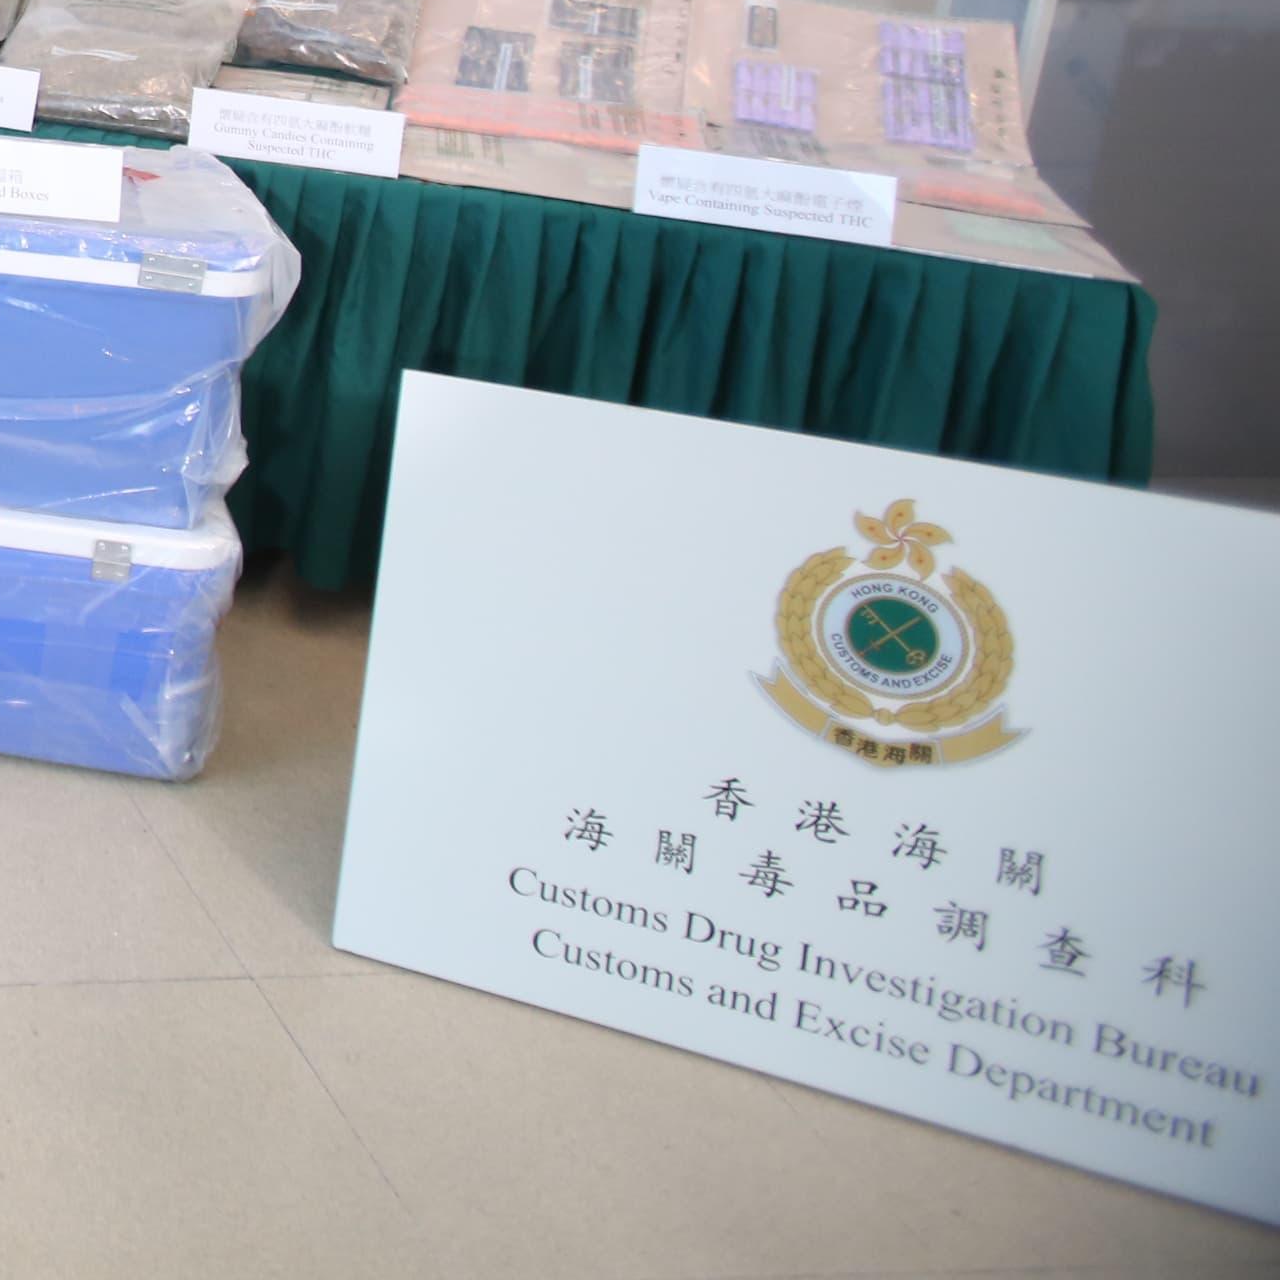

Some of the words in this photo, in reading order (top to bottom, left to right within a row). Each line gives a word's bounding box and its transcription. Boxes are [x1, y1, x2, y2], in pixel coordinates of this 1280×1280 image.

[213, 121, 259, 139] Gummy
[262, 127, 306, 142] Candies
[310, 134, 374, 153] Containing
[247, 139, 304, 157] Suspected
[308, 147, 338, 161] THC
[10, 187, 49, 202] Boxes
[648, 189, 680, 205] Vape
[684, 194, 759, 216] Containing
[763, 203, 834, 225] Suspected
[838, 213, 873, 229] THC
[851, 583, 893, 600] HONG
[898, 585, 939, 615] KONG
[831, 632, 880, 684] CUSTOMS
[881, 677, 912, 689] AND
[914, 654, 953, 687] EXCISE
[834, 726, 933, 766] 香港海關
[703, 776, 1046, 897] 香港海關
[563, 806, 1207, 1010] 海關毒品調查科
[508, 865, 669, 934] Customs
[683, 911, 784, 972] Drug
[798, 941, 1075, 1048] Investigation
[1091, 1022, 1262, 1102] Bureau
[531, 927, 694, 999] Customs
[706, 976, 779, 1023] and
[792, 1000, 932, 1067] Excise
[947, 1042, 1217, 1150] Department
